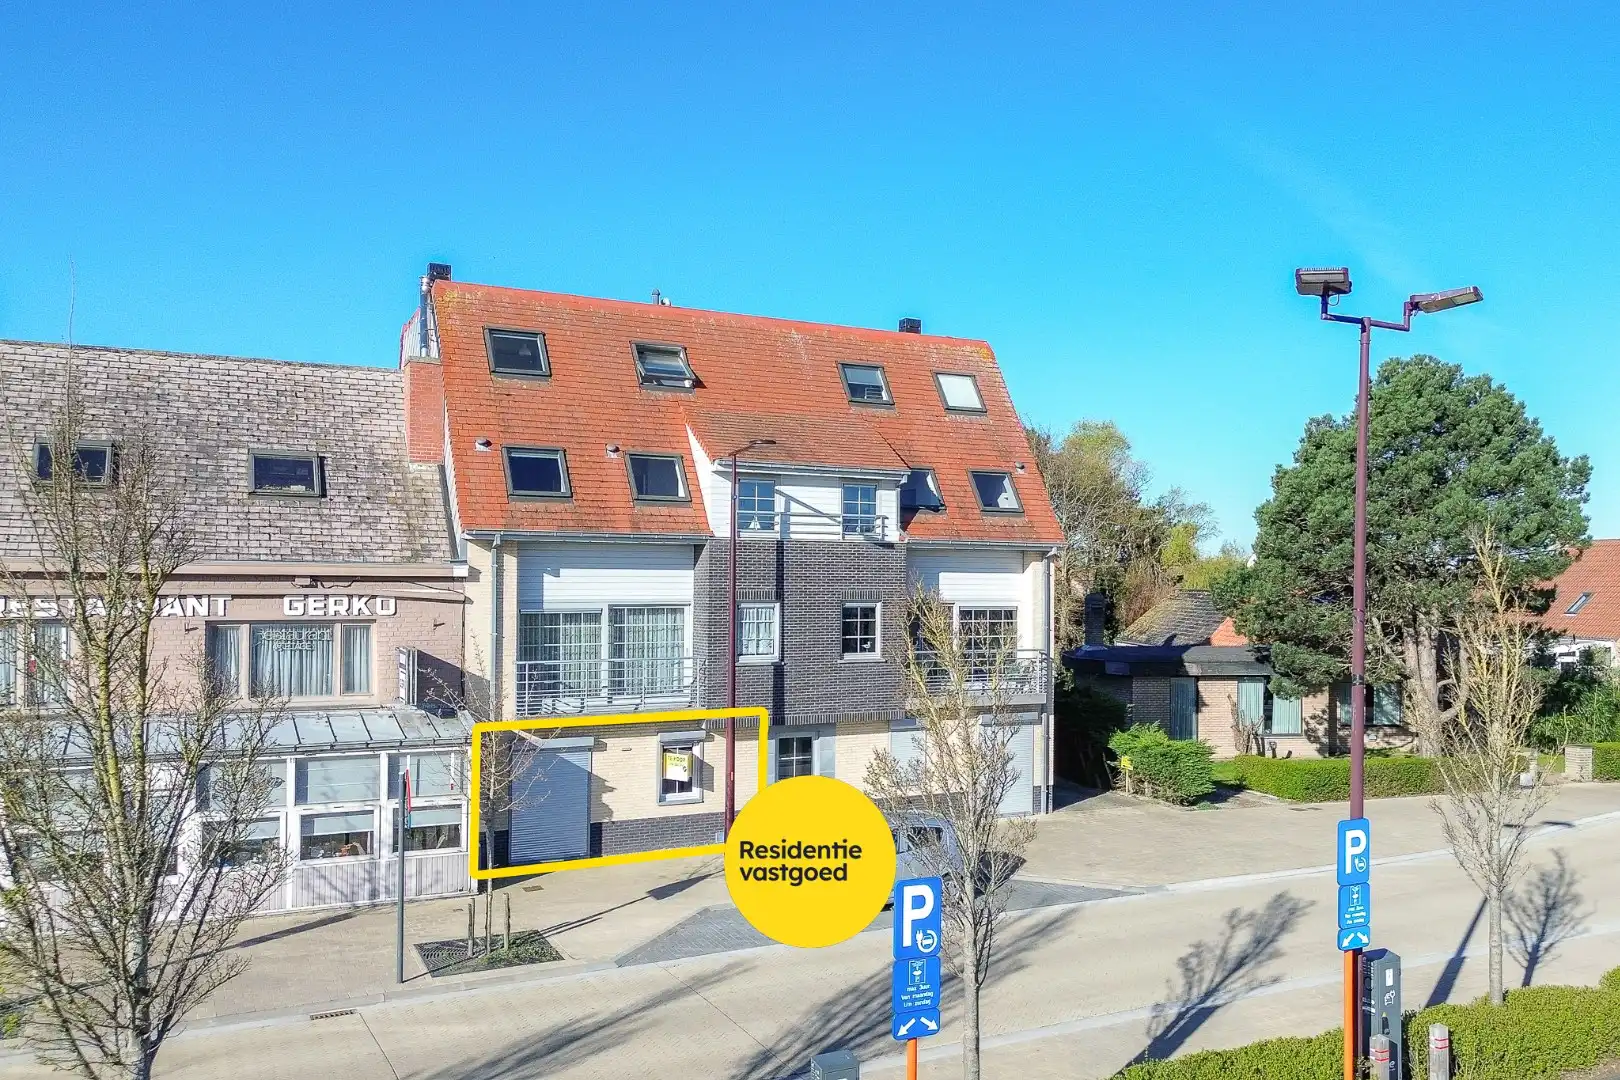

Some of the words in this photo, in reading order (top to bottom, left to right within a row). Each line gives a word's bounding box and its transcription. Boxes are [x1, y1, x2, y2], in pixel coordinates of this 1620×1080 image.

[0, 595, 232, 617] ESTAANT
[283, 594, 397, 617] GERKO
[1345, 829, 1367, 875] P
[902, 884, 935, 948] P
